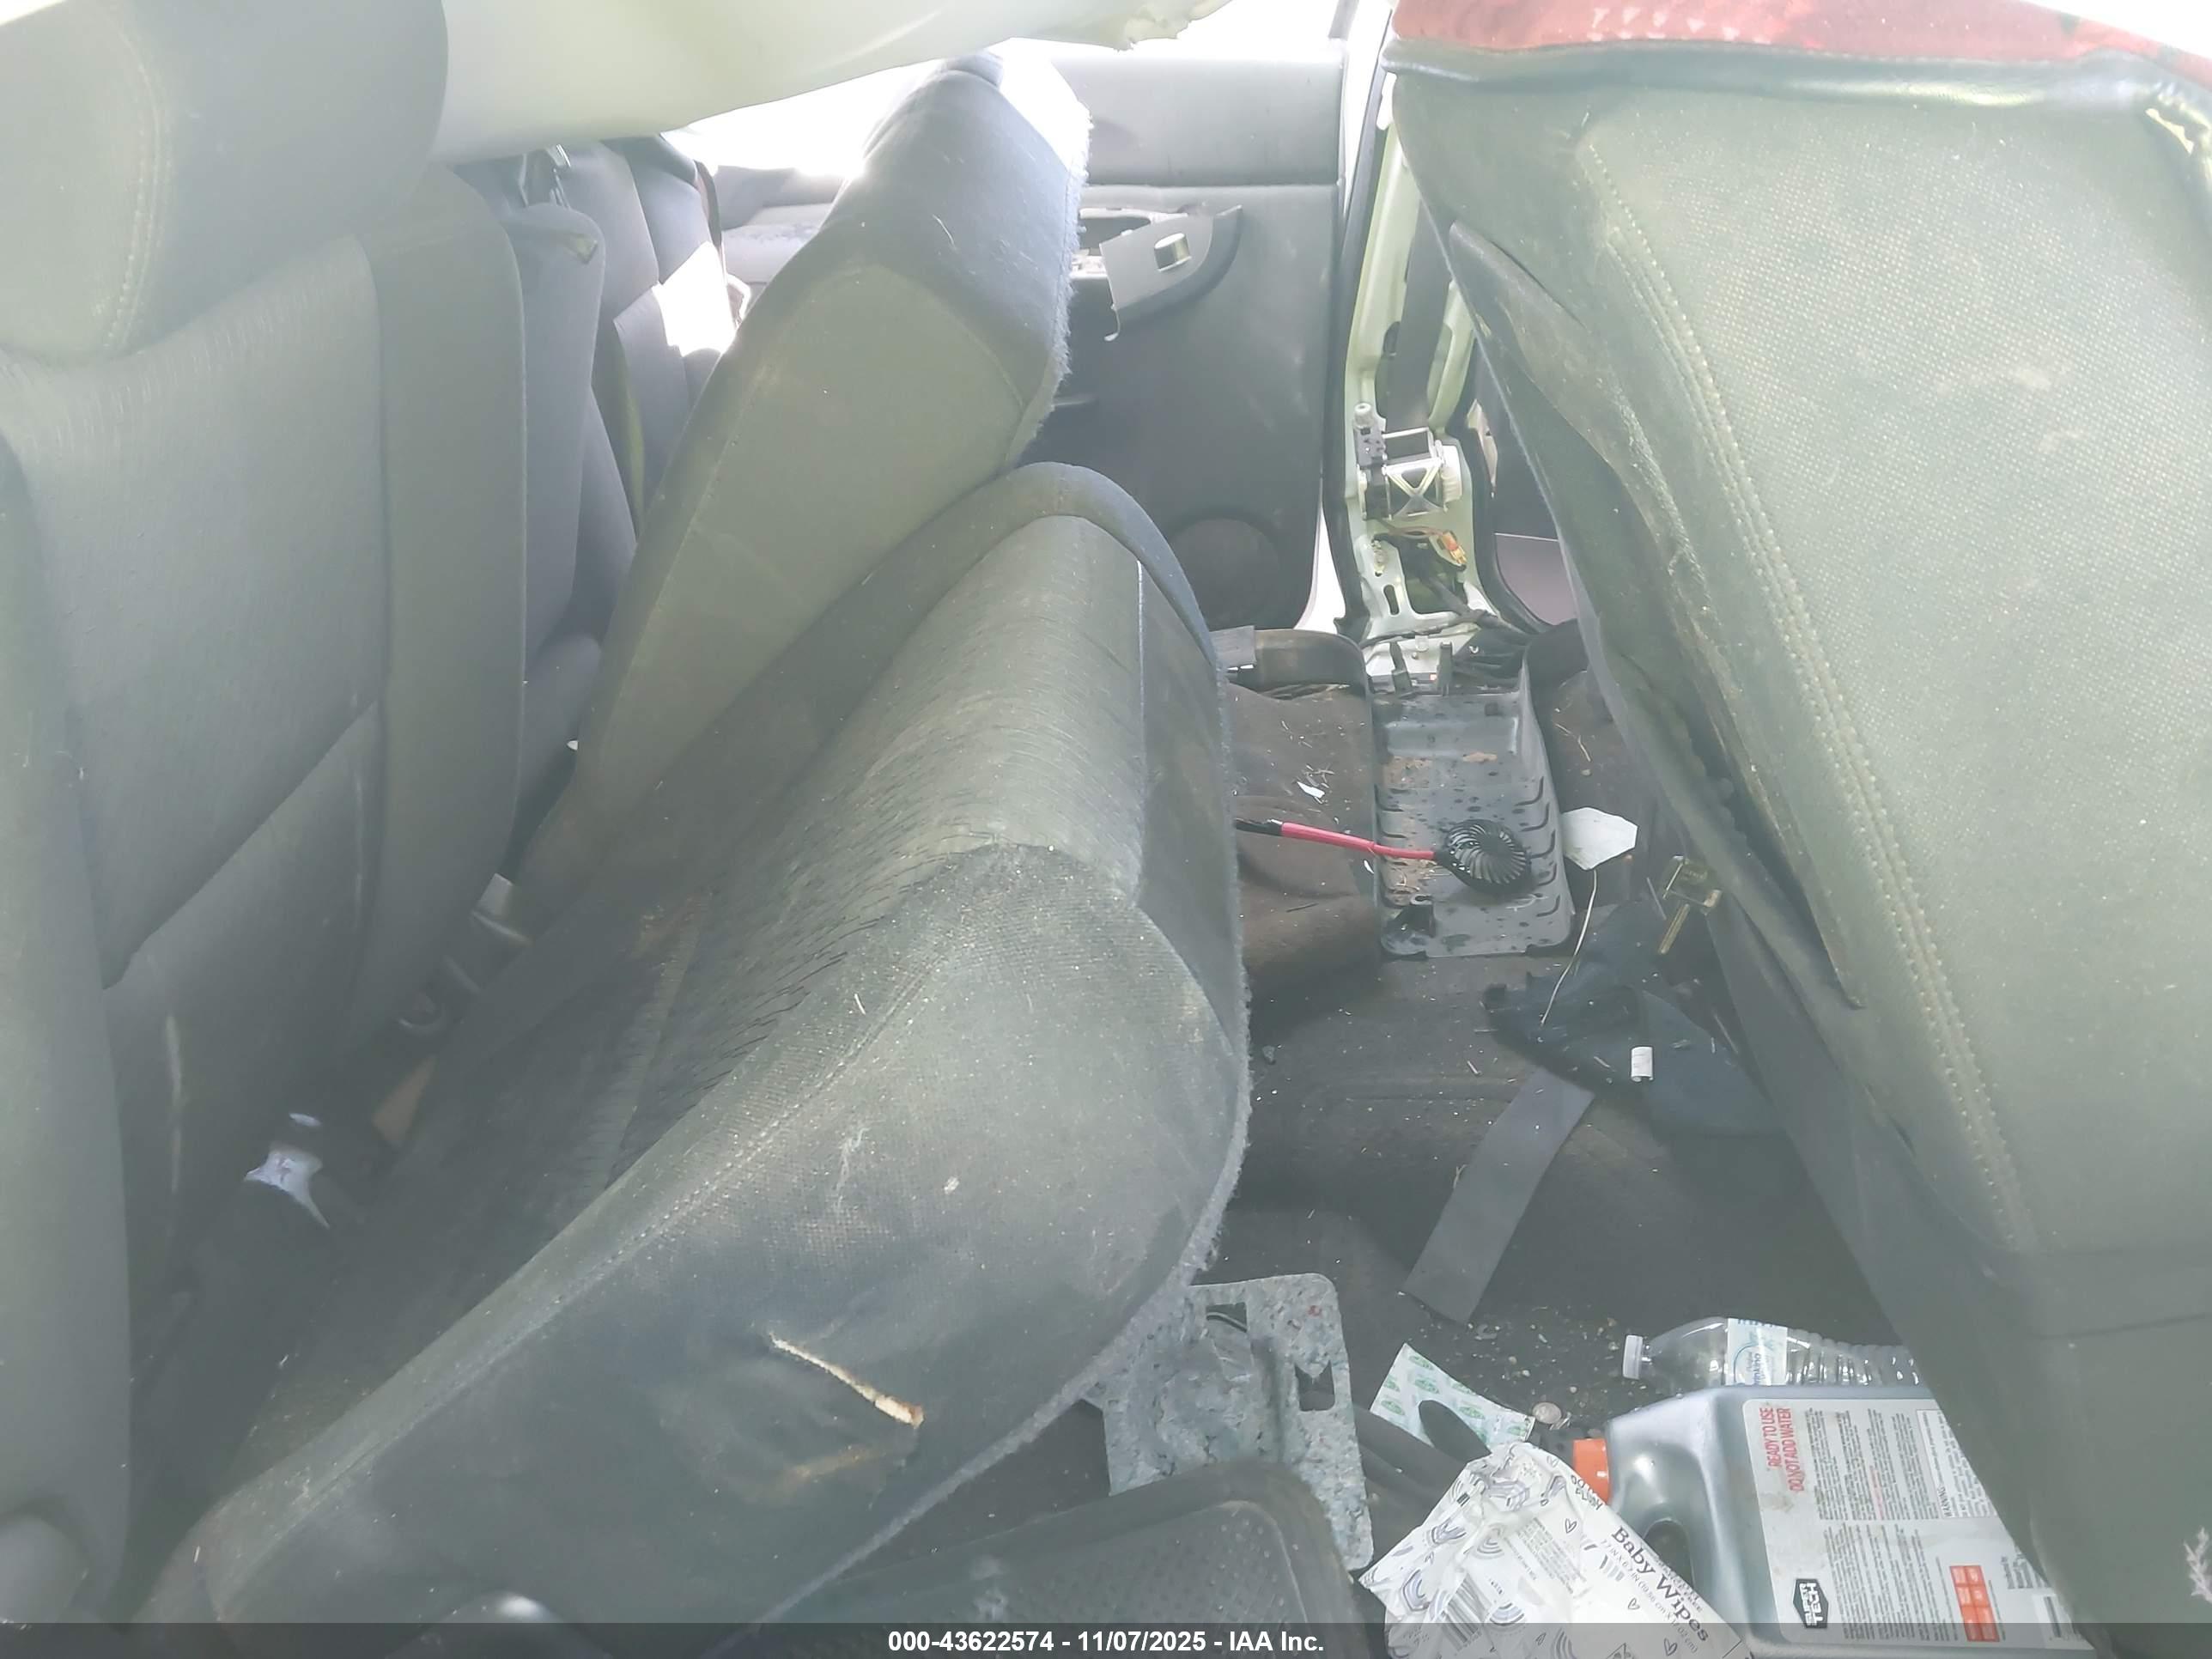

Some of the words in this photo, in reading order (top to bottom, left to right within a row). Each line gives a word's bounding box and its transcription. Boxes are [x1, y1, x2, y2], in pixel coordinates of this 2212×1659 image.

[1759, 1407, 1775, 1425] USE
[1777, 1408, 1794, 1439] WATER
[1762, 1425, 1778, 1437] TO
[1765, 1437, 1782, 1467] READY
[1781, 1439, 1798, 1459] ADD
[1785, 1459, 1803, 1478] NOT
[1788, 1478, 1804, 1491] DO
[1611, 1526, 1656, 1574] Baby
[1656, 1573, 1709, 1641] Wipes
[1799, 1583, 1812, 1626] SUPER
[1807, 1583, 1823, 1626] TECH
